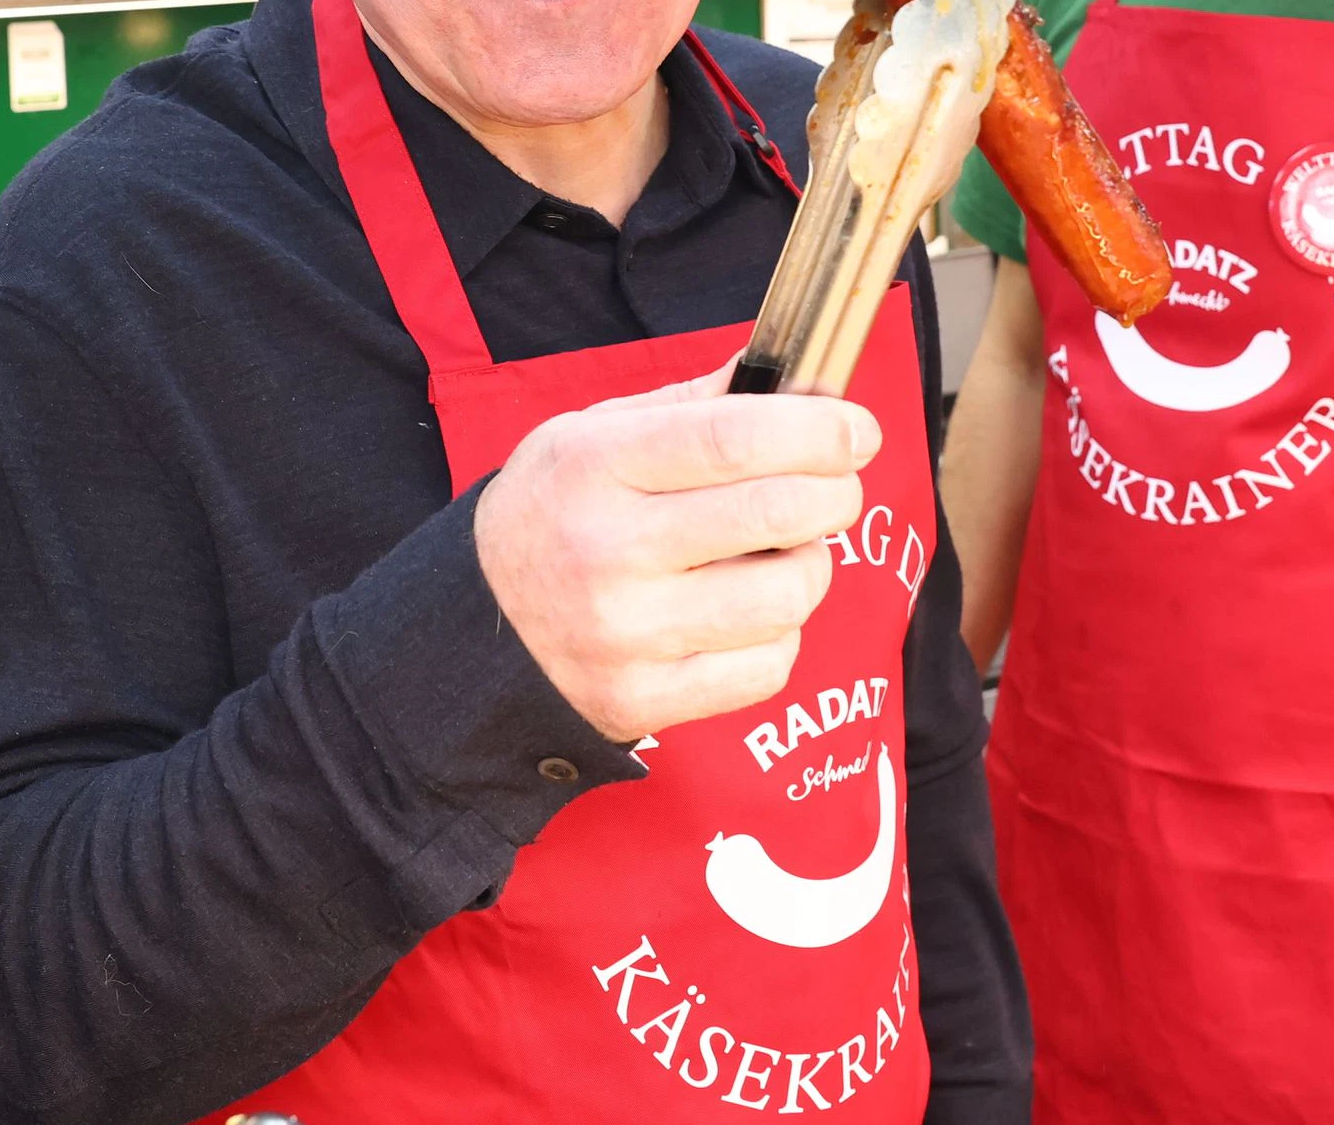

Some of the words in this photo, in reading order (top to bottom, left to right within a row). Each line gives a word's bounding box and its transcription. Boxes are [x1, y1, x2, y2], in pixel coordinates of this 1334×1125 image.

[1121, 123, 1265, 185] TTAG
[1163, 239, 1259, 295] DATZ
[743, 677, 889, 773] RADAT
[591, 923, 911, 1116] KÄSEKRAI
